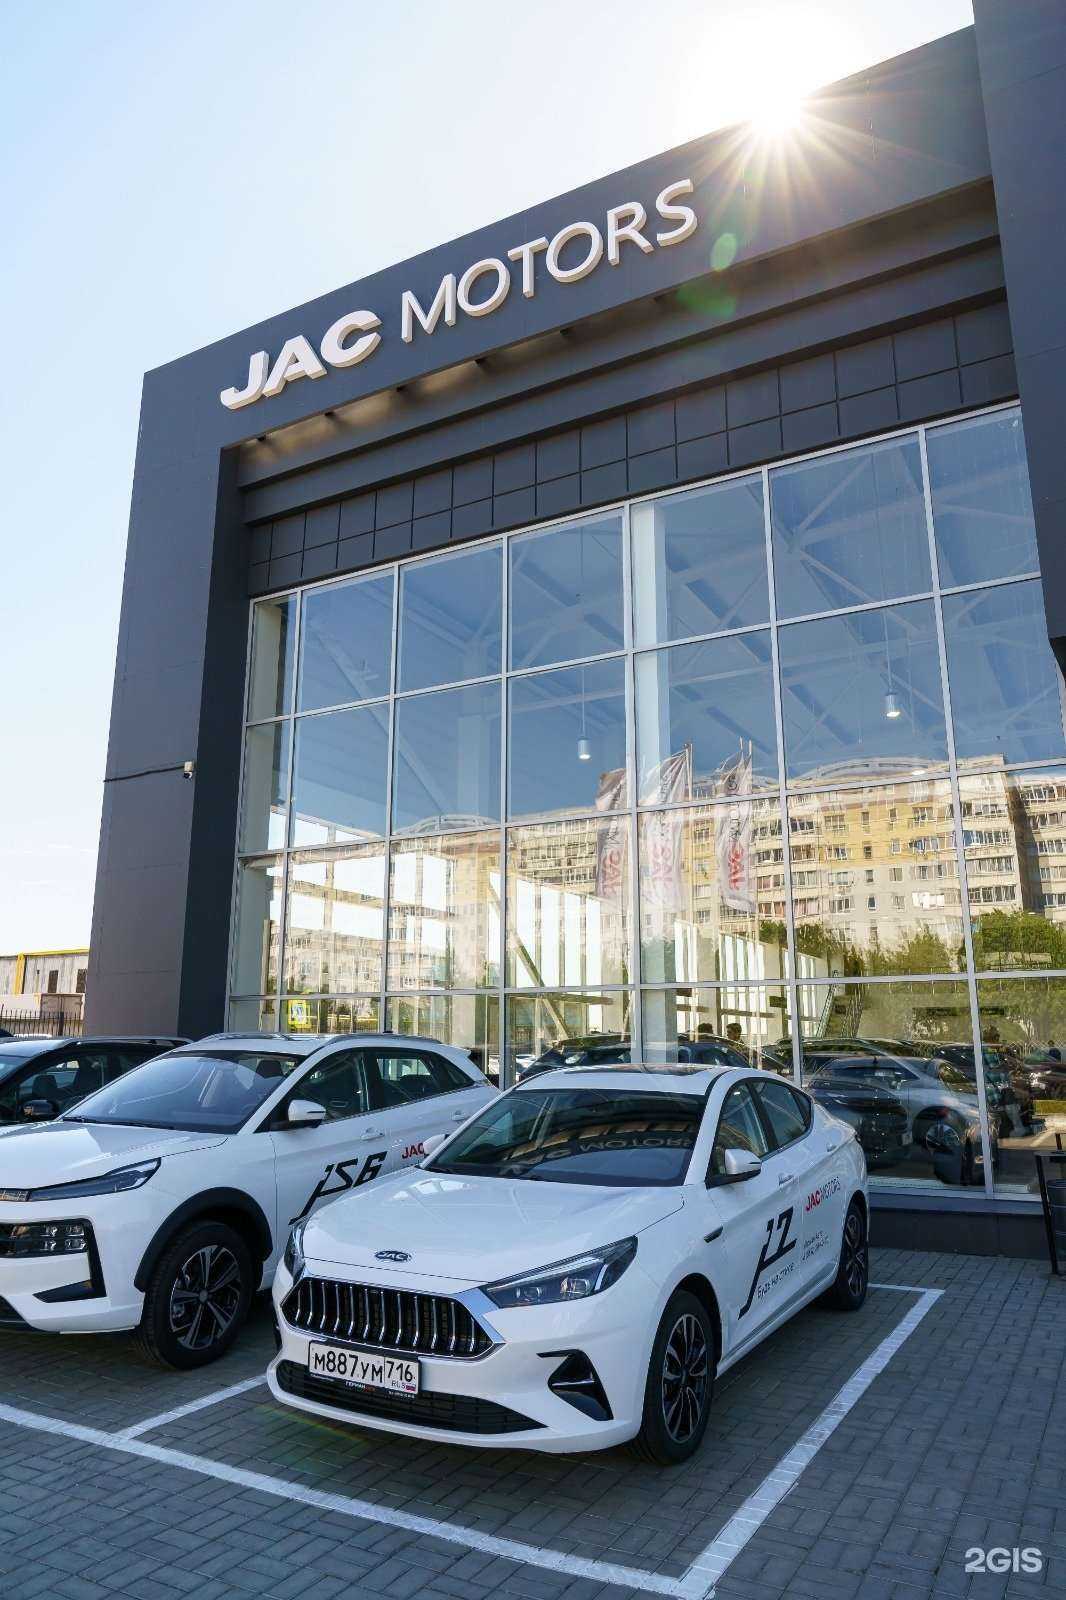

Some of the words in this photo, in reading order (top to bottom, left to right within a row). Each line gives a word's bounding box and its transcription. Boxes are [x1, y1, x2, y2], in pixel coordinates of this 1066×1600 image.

[220, 310, 382, 410] JAC
[401, 178, 698, 343] MOTORS
[386, 1361, 413, 1382] 716
